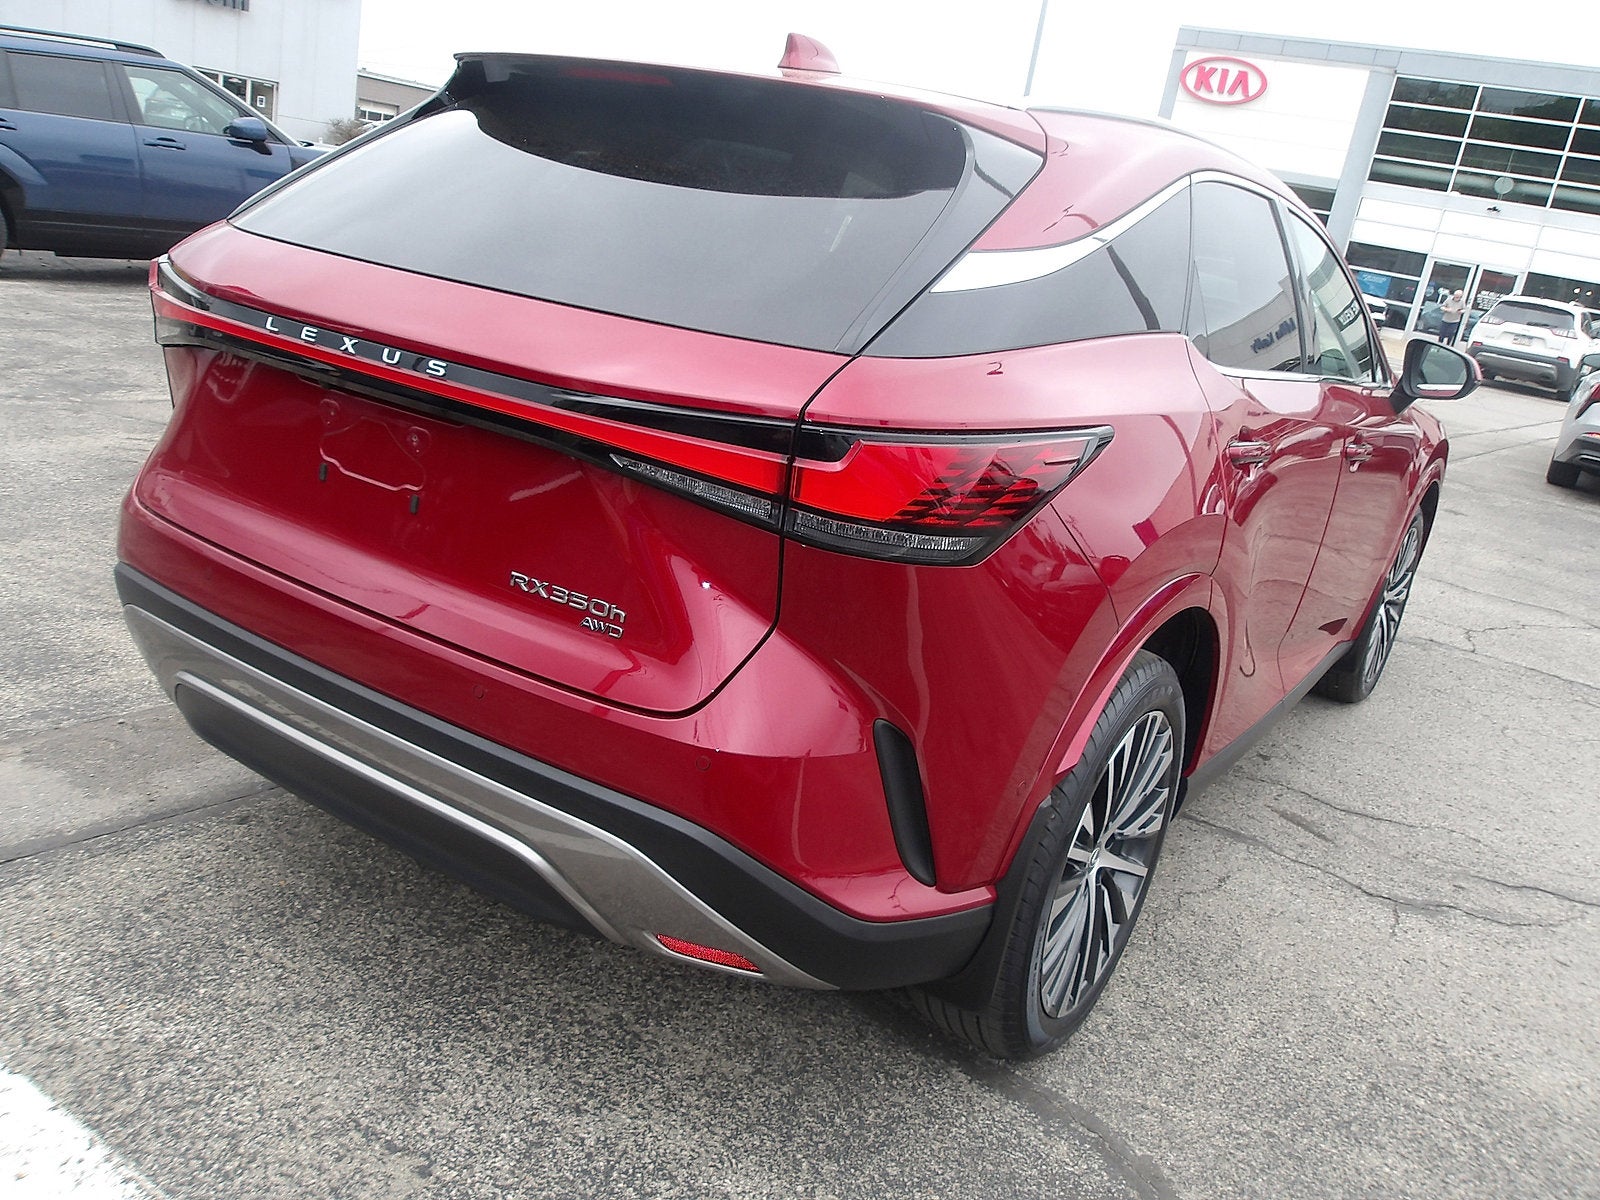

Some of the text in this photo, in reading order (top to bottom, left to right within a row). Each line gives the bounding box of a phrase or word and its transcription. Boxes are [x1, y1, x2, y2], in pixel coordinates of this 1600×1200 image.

[1194, 65, 1249, 98] KIA
[265, 316, 448, 377] LEXUS
[509, 570, 626, 623] RX350h
[580, 616, 624, 639] AWD
